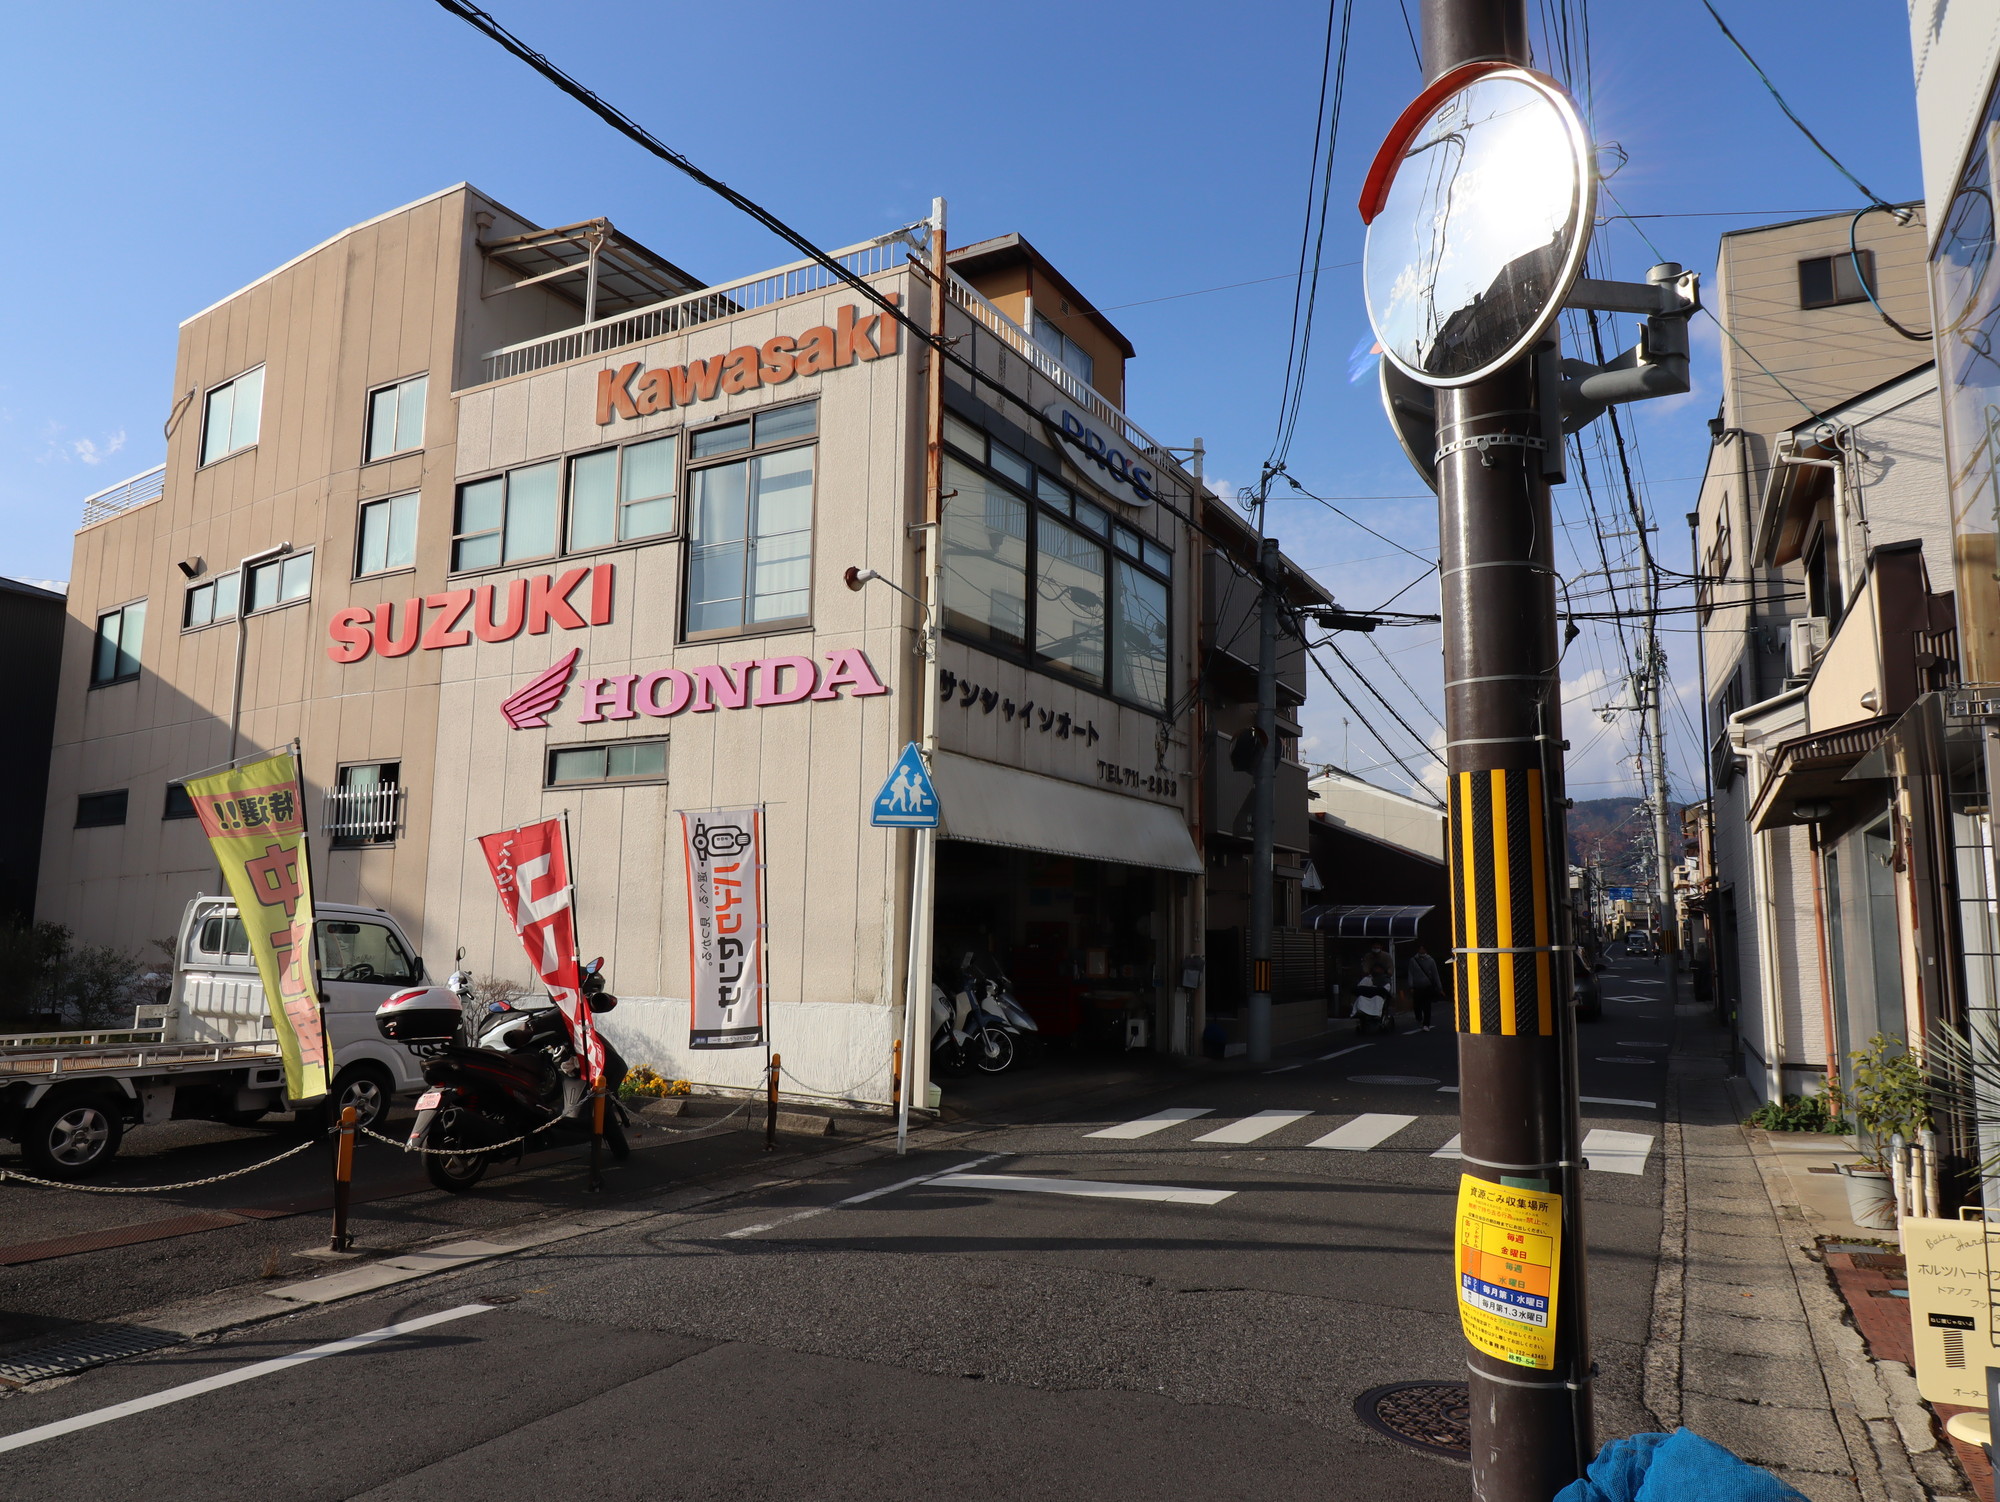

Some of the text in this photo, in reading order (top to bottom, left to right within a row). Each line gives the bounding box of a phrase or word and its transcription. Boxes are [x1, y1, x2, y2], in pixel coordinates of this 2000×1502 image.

[596, 294, 901, 426] Kawasaki
[1062, 409, 1152, 500] PRO'S
[328, 564, 613, 663] SUZUKI
[578, 649, 887, 723] HONDA
[940, 668, 1099, 747] サンシャインオート
[1470, 1186, 1549, 1213] 資源ごみ収集場所
[1501, 1246, 1527, 1260] 金曜日
[1507, 1232, 1525, 1245] 毎週
[1499, 1276, 1526, 1289] 水曜日
[1505, 1261, 1523, 1274] 毎週
